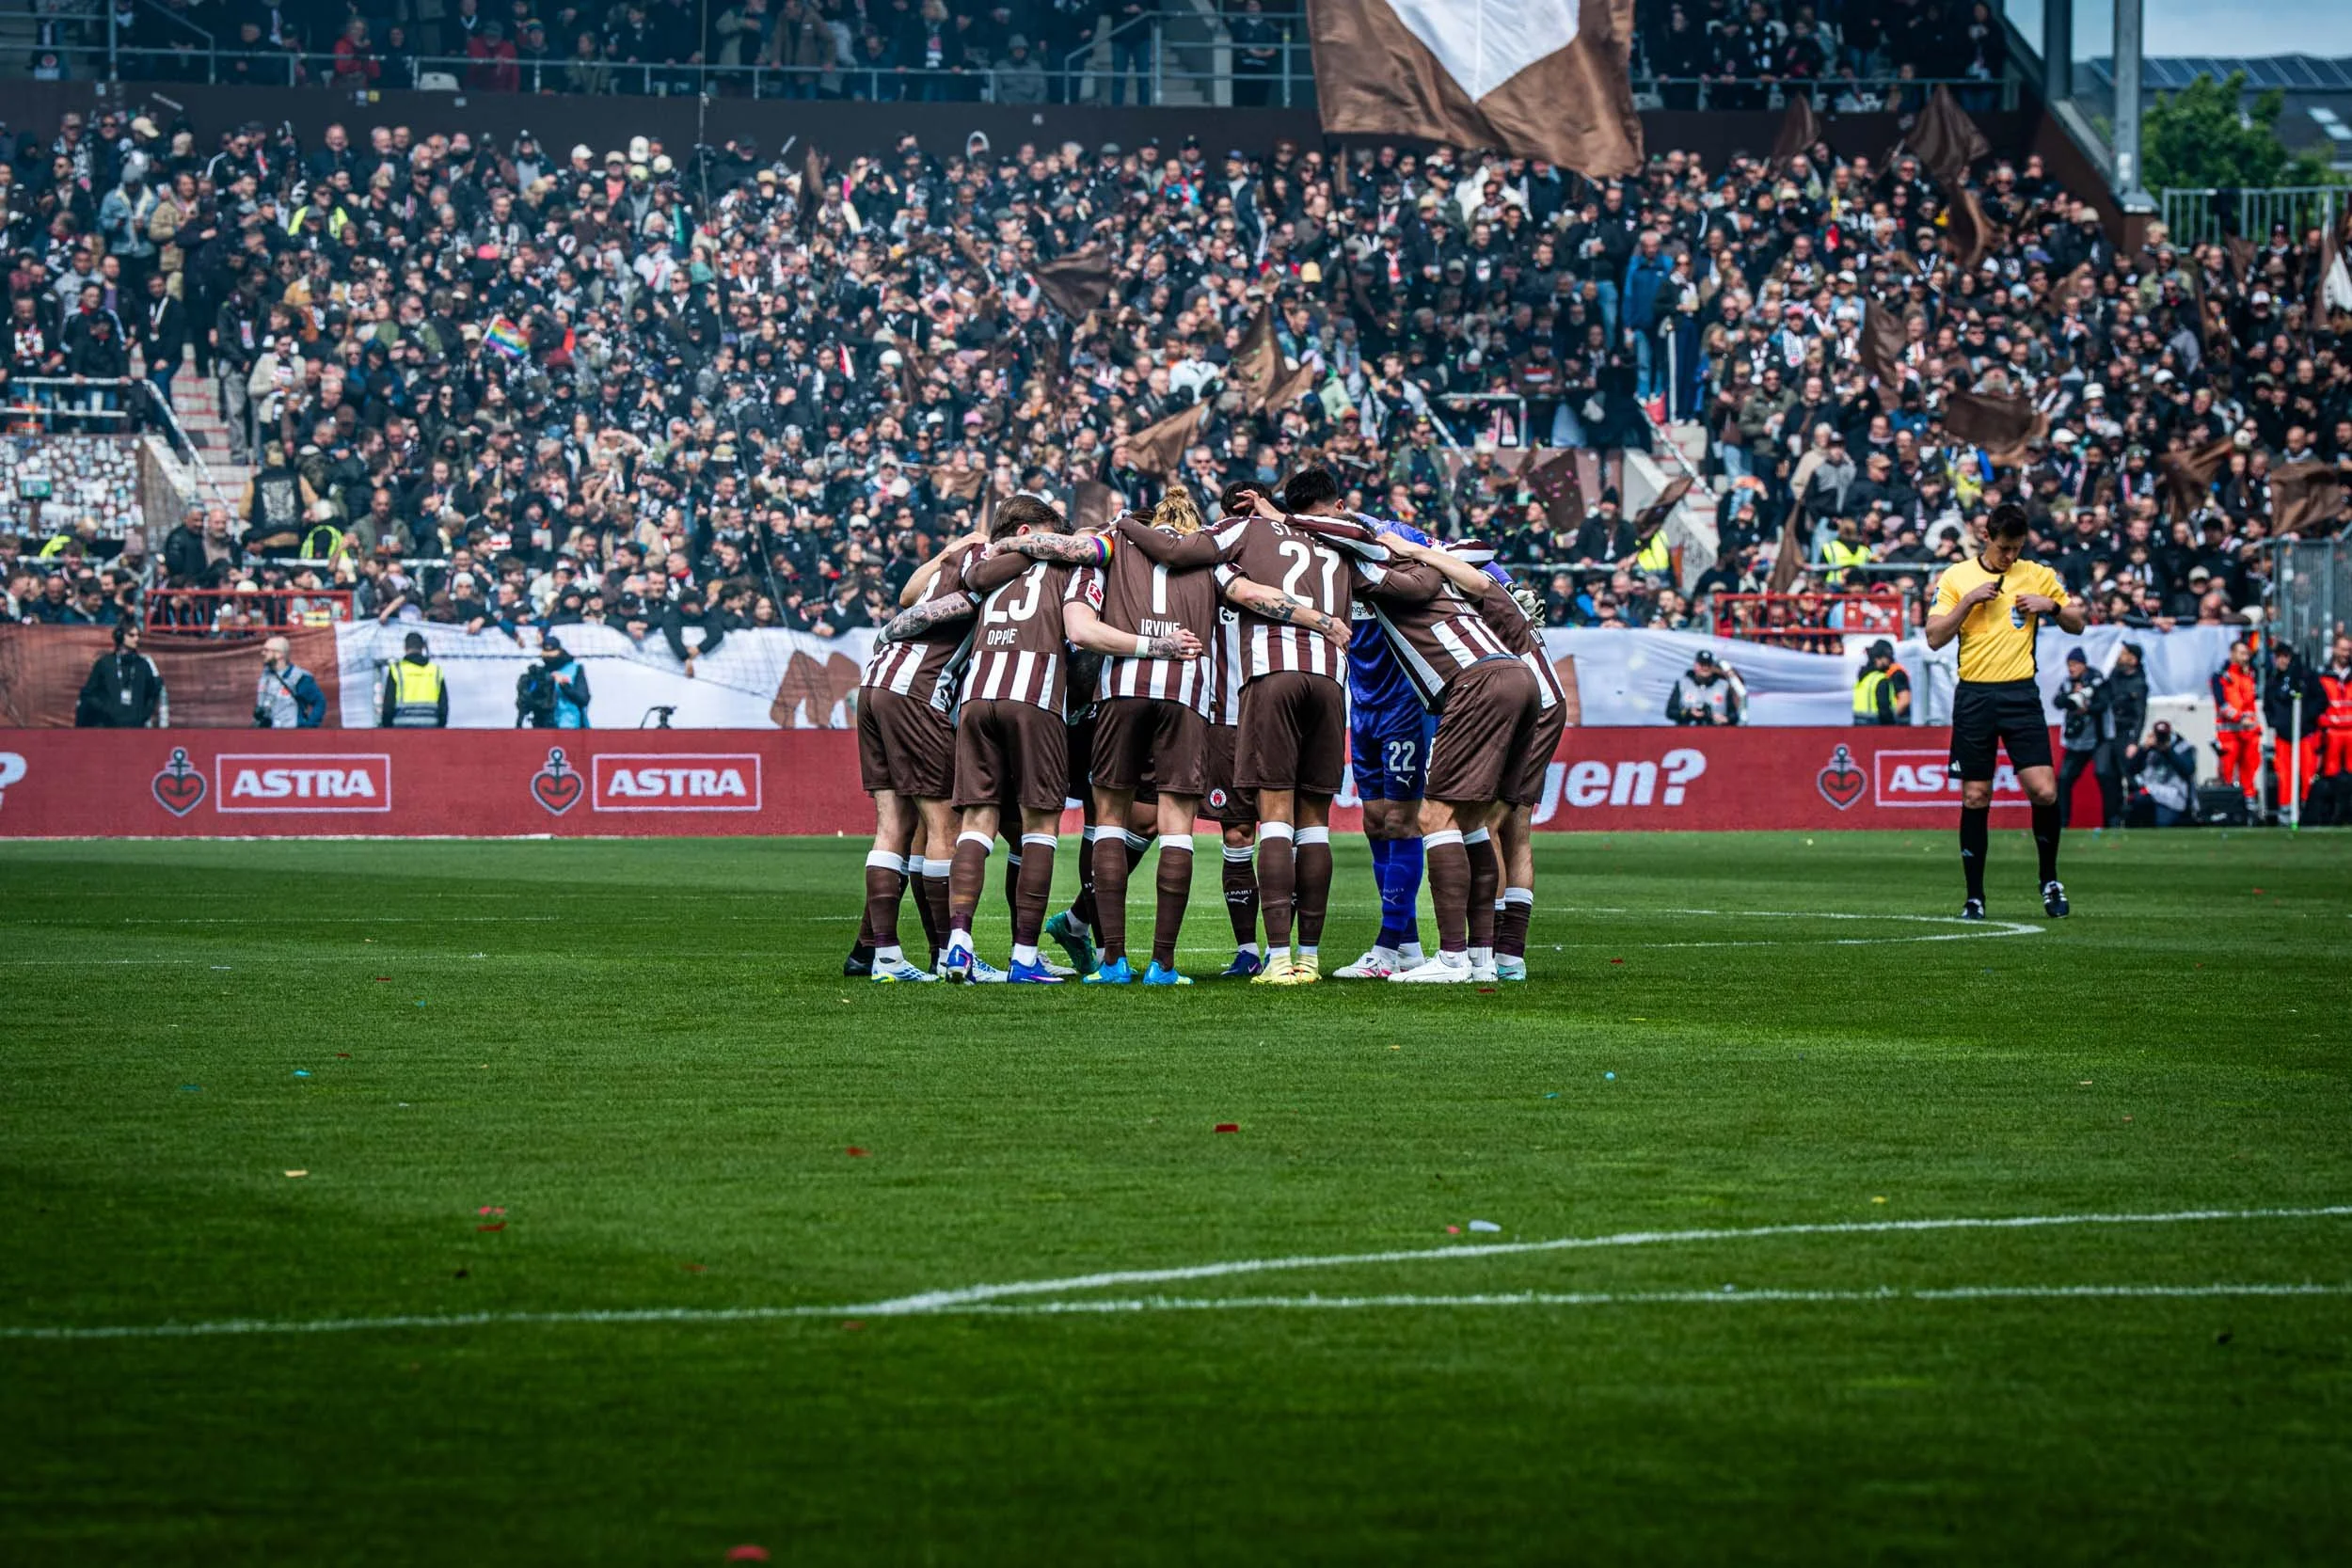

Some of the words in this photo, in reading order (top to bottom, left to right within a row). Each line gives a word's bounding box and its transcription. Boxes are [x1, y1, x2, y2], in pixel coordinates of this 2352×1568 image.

[984, 561, 1048, 626] 23
[1279, 540, 1341, 615] 27
[1388, 740, 1416, 772] 22
[230, 768, 376, 798] ASTRA
[607, 768, 747, 798] ASTRA
